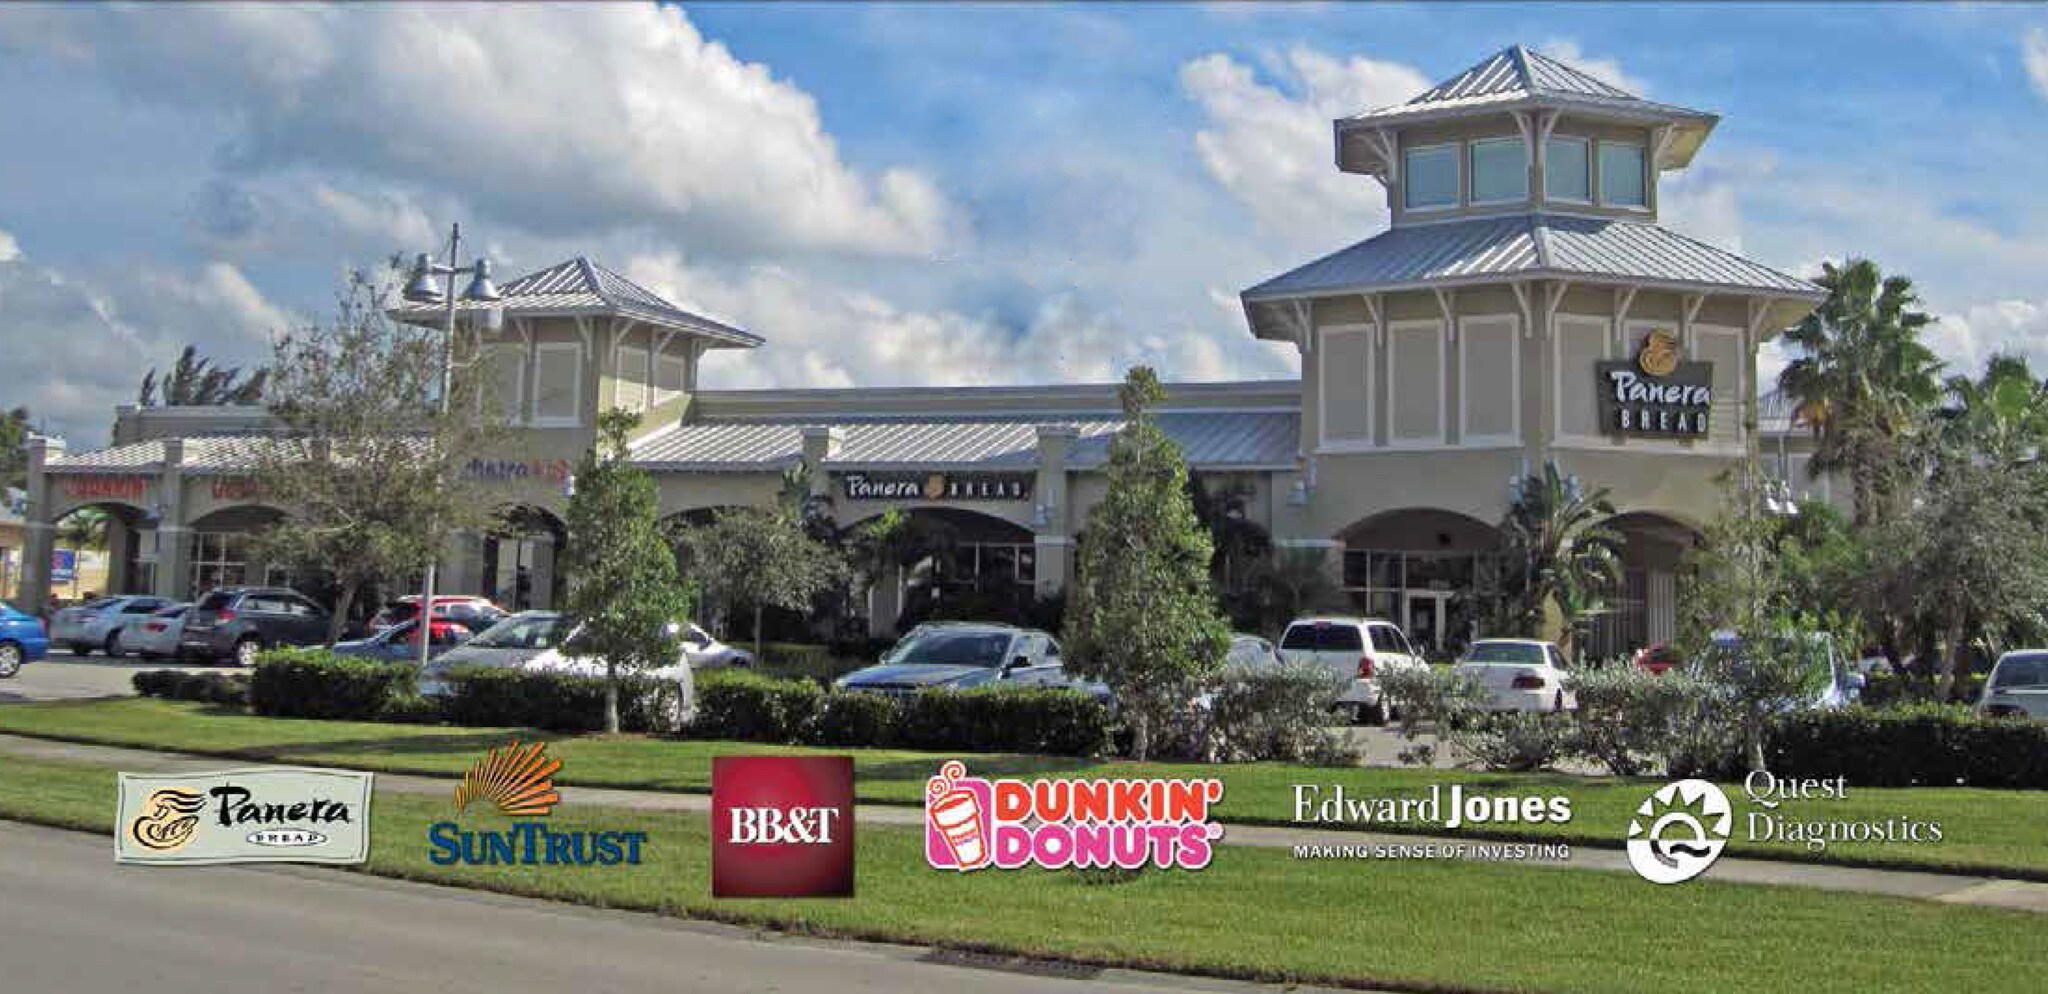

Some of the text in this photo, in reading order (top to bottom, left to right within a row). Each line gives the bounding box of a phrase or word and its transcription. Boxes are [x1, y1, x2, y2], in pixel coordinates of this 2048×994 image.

[1611, 371, 1711, 404] Panera
[1621, 408, 1706, 432] BREAD
[847, 475, 919, 496] Panera
